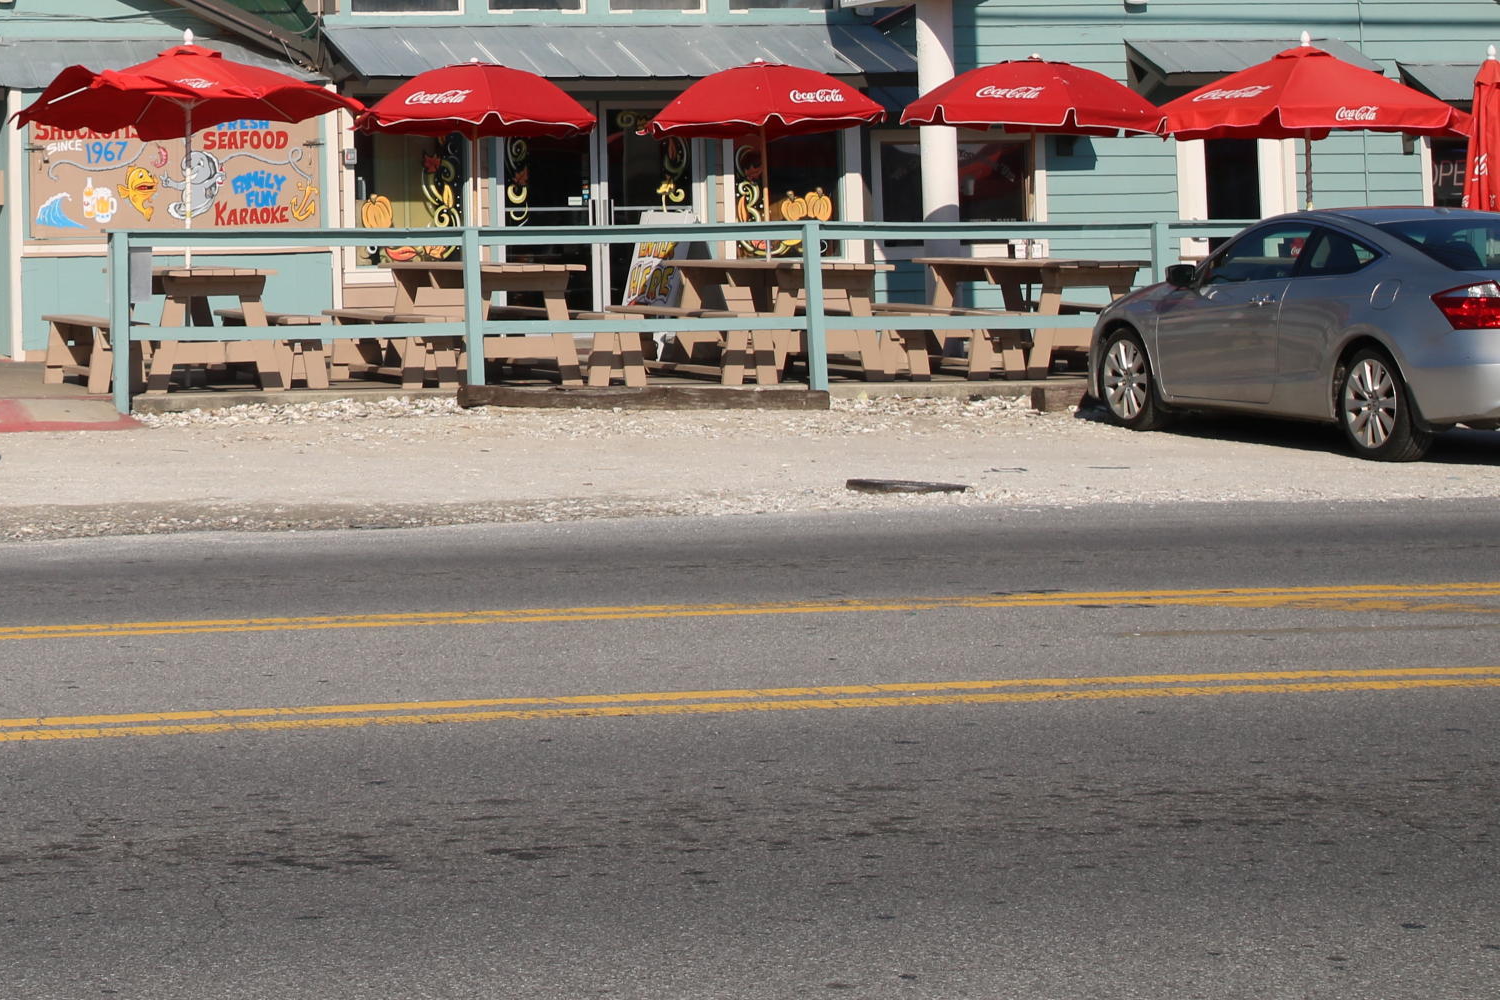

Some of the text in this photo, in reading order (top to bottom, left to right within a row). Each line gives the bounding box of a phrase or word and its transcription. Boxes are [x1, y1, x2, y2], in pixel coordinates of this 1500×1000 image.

[404, 88, 473, 105] Coca-Cola
[789, 88, 845, 103] Coca-Cola
[975, 85, 1045, 99] Coca-Cola
[1192, 85, 1273, 102] Coca-Cola
[1335, 105, 1380, 121] Coca-Cola
[203, 131, 288, 150] SEAFOOD
[46, 140, 129, 164] SINCE 1967
[245, 190, 278, 208] FUN
[214, 201, 289, 226] KARAOKE
[627, 261, 676, 304] HERE
